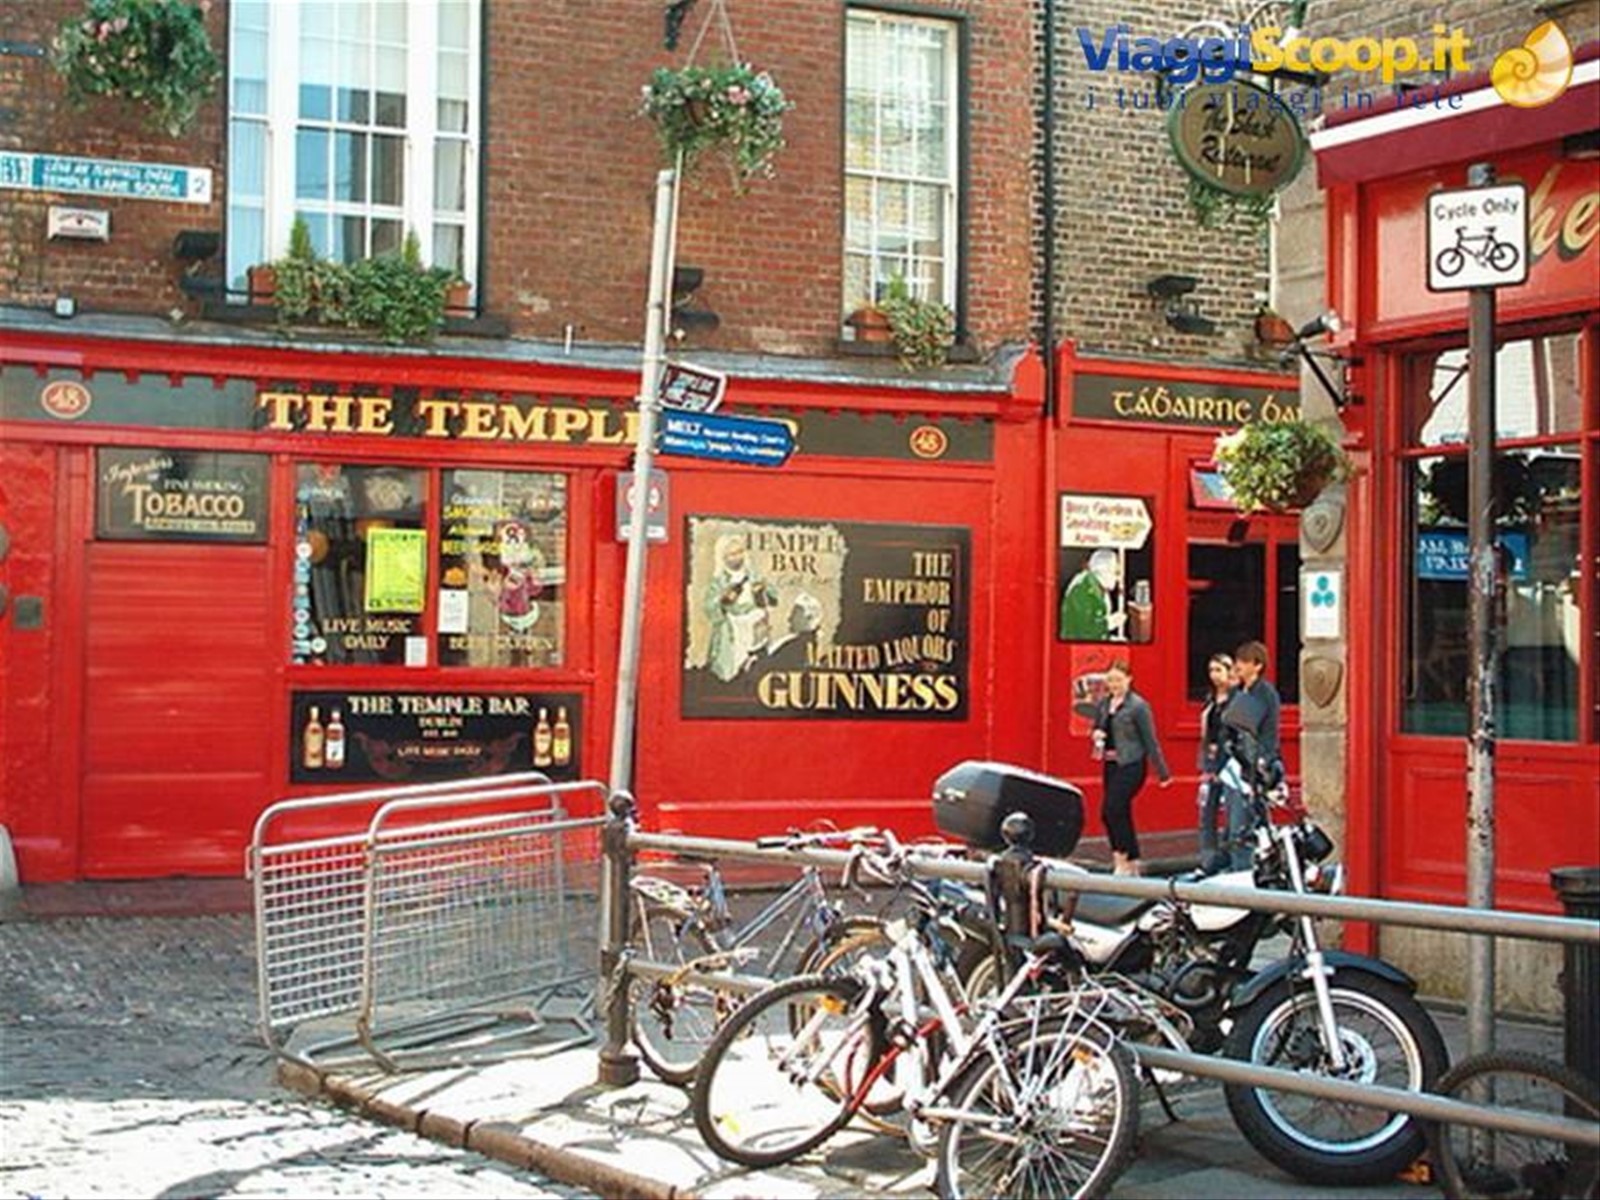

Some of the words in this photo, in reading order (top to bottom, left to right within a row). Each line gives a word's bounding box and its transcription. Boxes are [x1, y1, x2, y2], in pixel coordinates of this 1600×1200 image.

[1434, 203, 1478, 221] Cycle
[1482, 197, 1519, 216] Only
[260, 392, 394, 435] THE
[123, 484, 244, 524] TOBACCO
[771, 552, 817, 576] BAR
[913, 552, 951, 577] THE
[863, 578, 950, 605] EMPEROR
[927, 609, 949, 632] OF
[758, 671, 958, 710] GUINNESS
[348, 696, 393, 714] THE
[398, 696, 483, 715] TEMPLE
[488, 697, 530, 716] BAR
